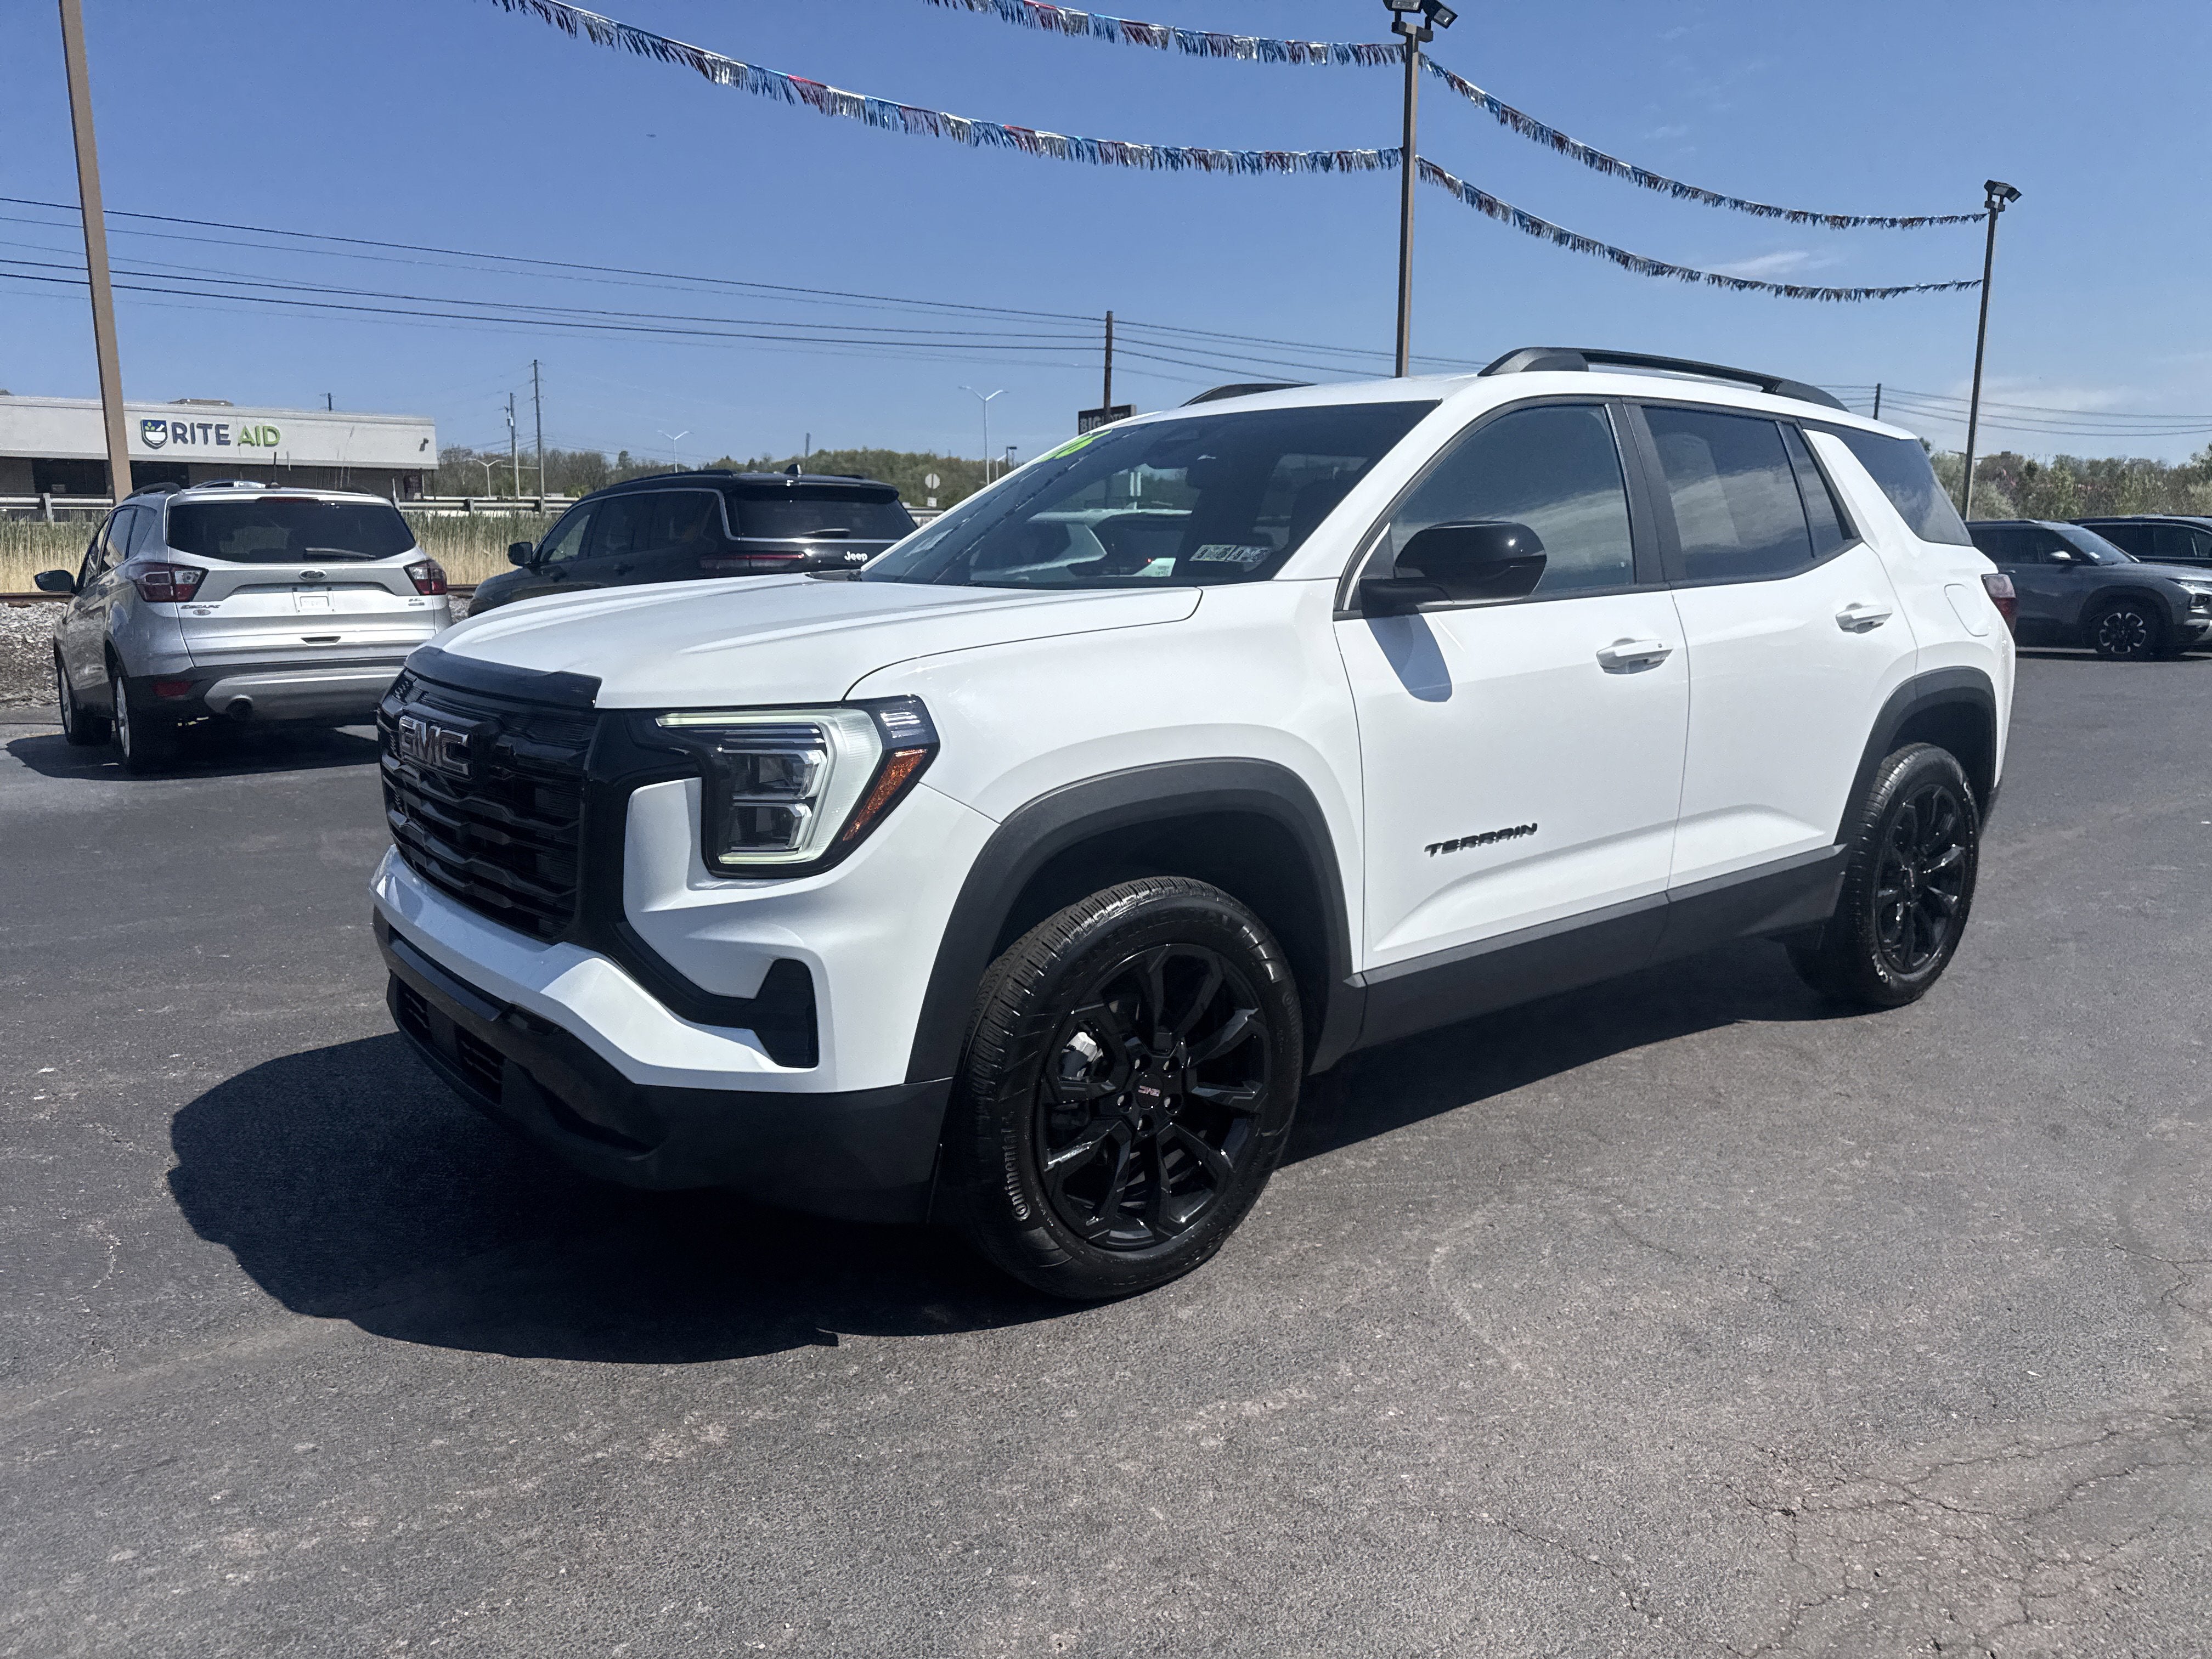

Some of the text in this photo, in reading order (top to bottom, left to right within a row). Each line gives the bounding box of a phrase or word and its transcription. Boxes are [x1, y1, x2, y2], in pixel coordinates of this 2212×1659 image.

[171, 422, 280, 447] RITE AID
[1080, 416, 1101, 432] BIG
[844, 551, 868, 562] Jeep
[399, 715, 469, 776] GMC
[1424, 822, 1538, 857] TERRAIN
[1138, 1085, 1160, 1097] GMC
[1001, 1128, 1031, 1221] Continental
